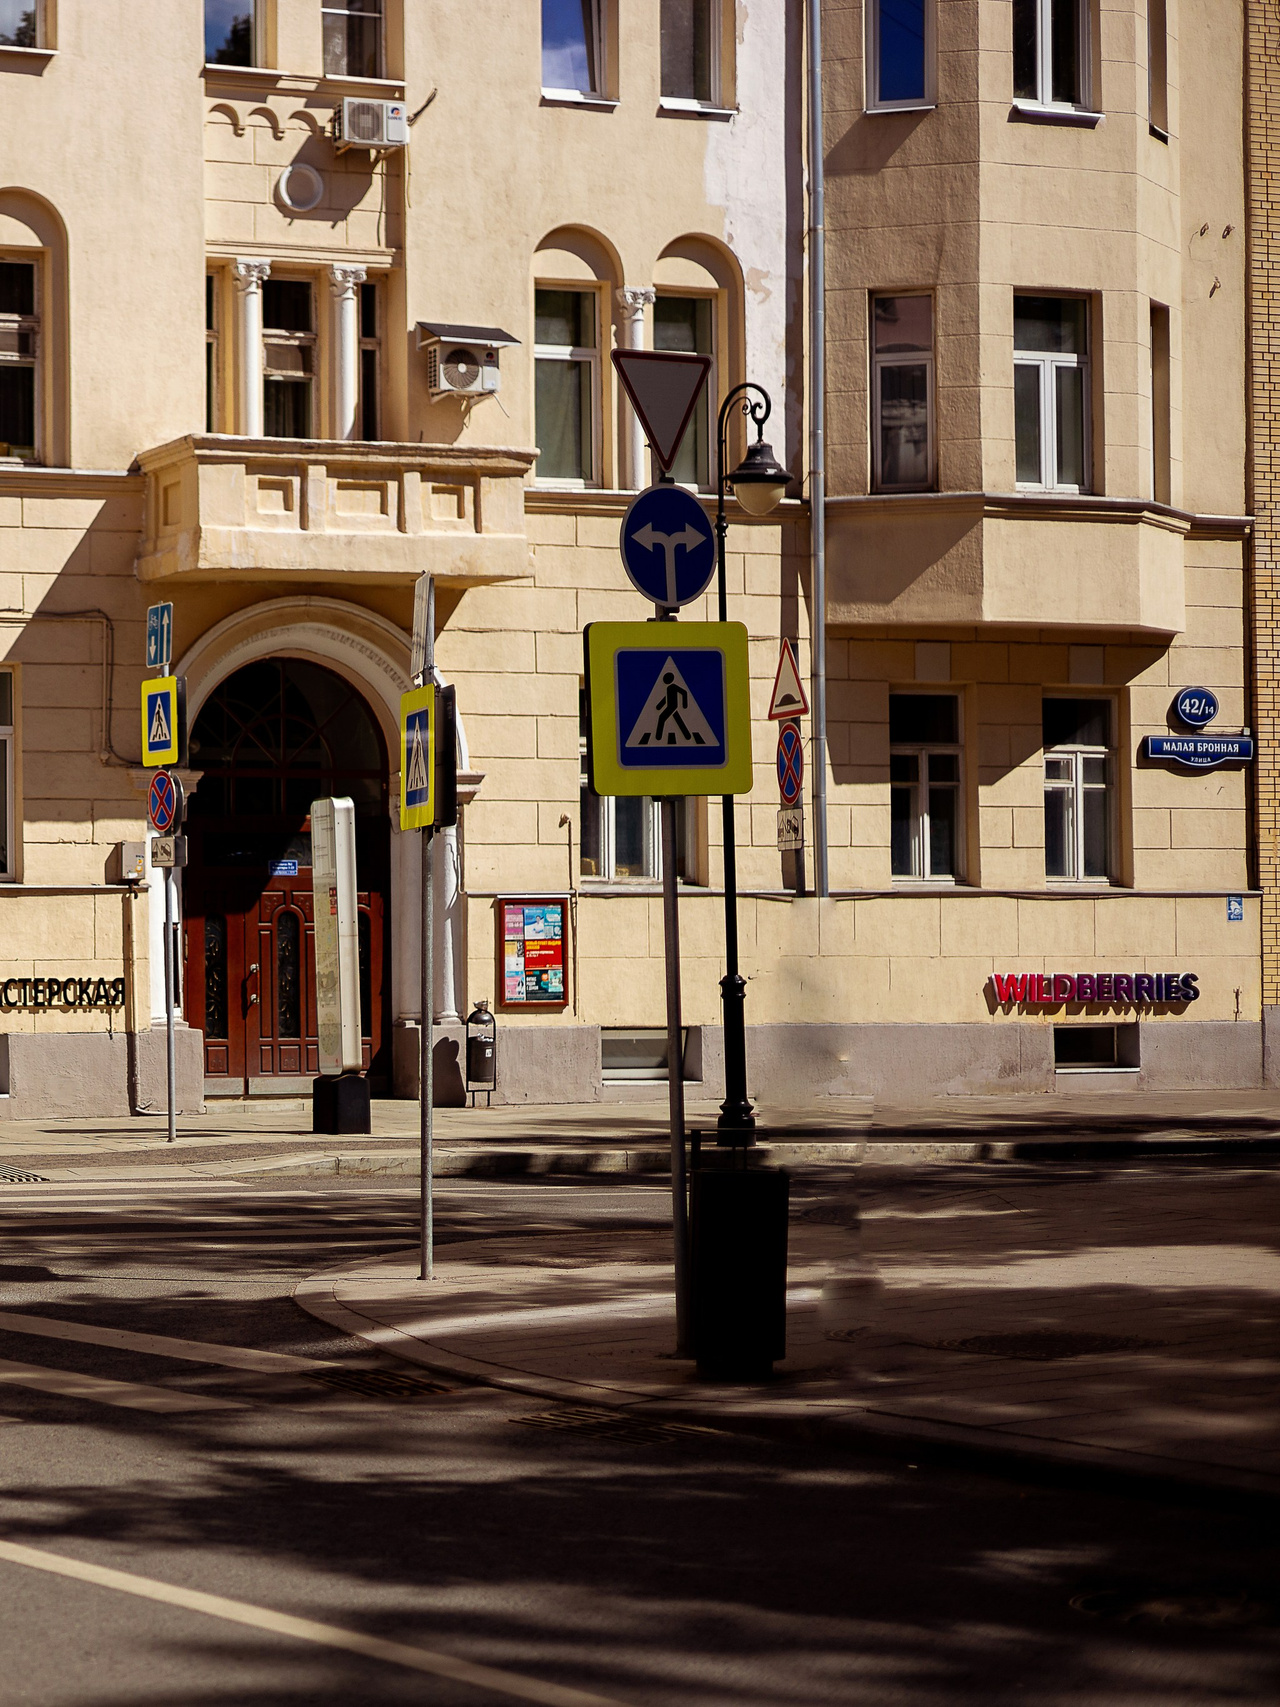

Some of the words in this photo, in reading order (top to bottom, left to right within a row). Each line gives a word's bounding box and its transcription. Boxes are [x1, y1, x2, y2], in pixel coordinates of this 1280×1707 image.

[1181, 698, 1214, 715] 42/14
[1163, 741, 1194, 752] МАЛАЯ
[1197, 742, 1239, 753] БРОННАЯ
[992, 972, 1201, 1003] WILDBERRIES
